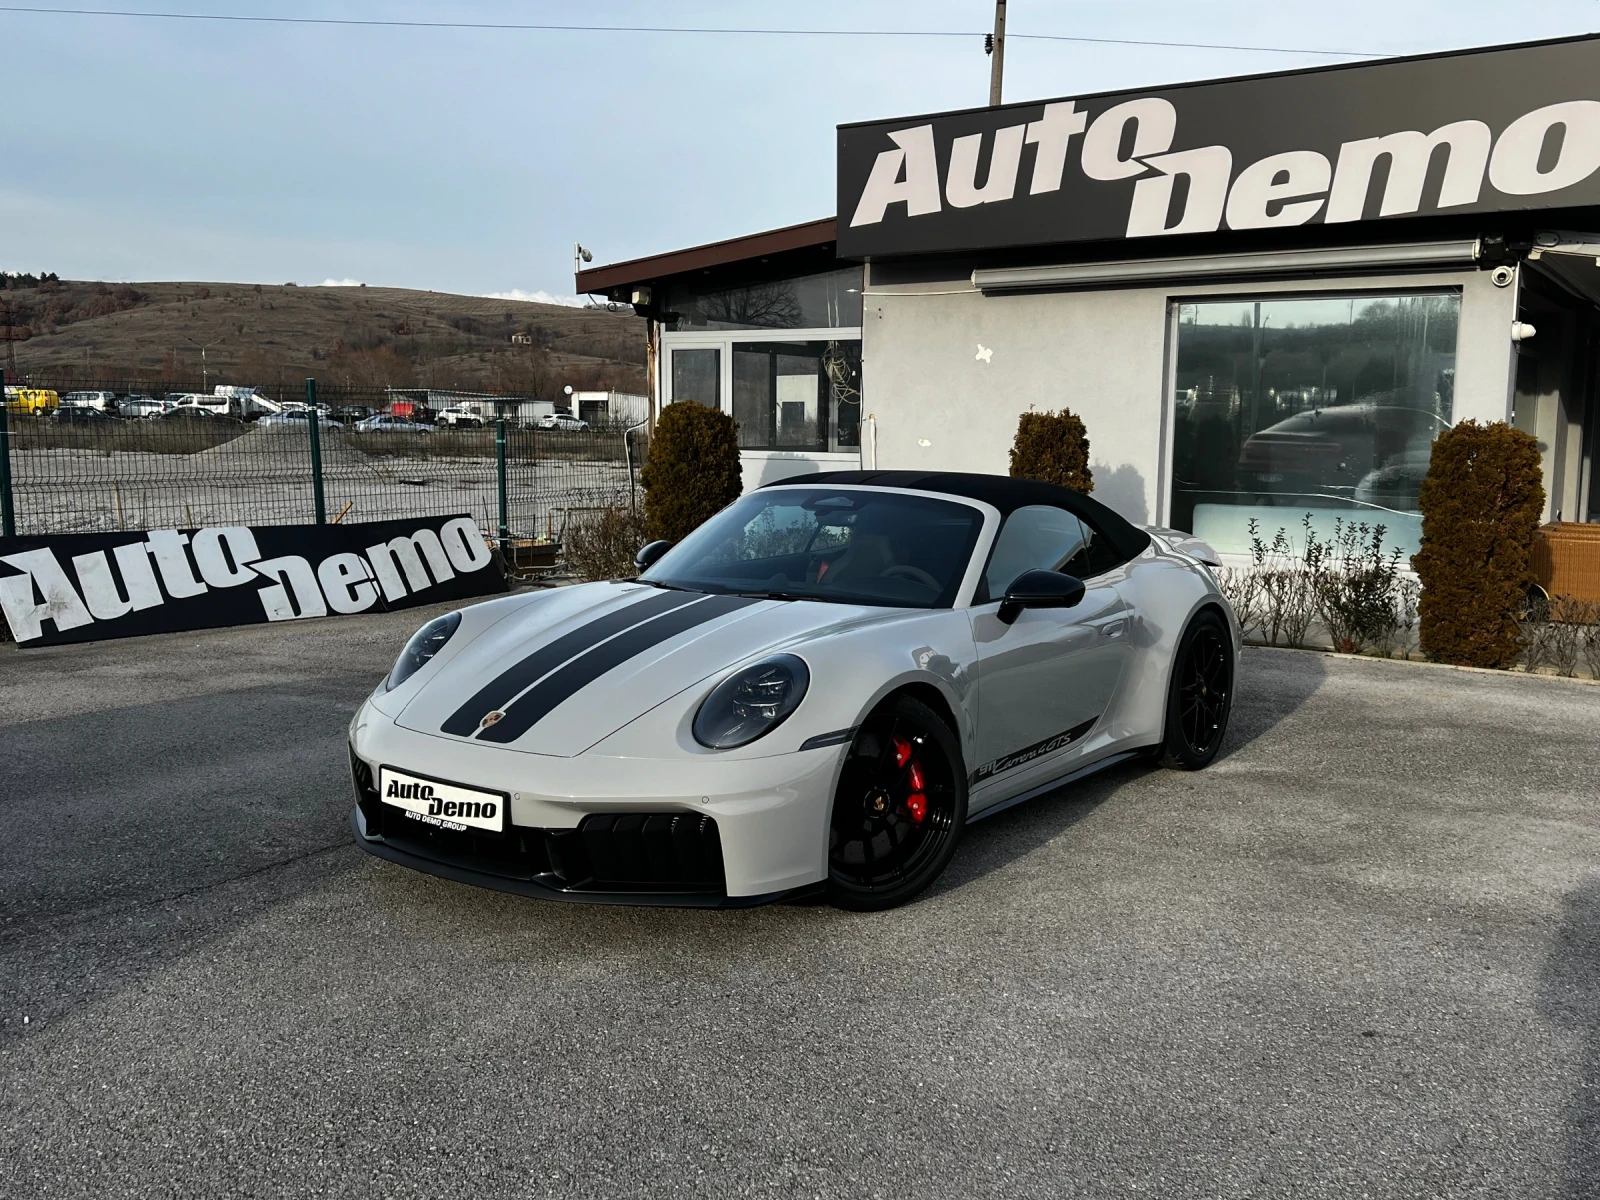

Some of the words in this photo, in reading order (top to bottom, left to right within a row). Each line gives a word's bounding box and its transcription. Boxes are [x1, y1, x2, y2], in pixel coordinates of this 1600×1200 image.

[850, 97, 1177, 228] Auto
[1125, 99, 1600, 238] Demo
[0, 526, 262, 643] Auto
[249, 517, 492, 622] Demo
[991, 749, 1037, 775] Carrera
[386, 779, 434, 801] Auto
[428, 796, 497, 819] Demo
[404, 810, 421, 821] AUTO
[421, 815, 442, 826] DEMO
[442, 820, 468, 832] GROUP
